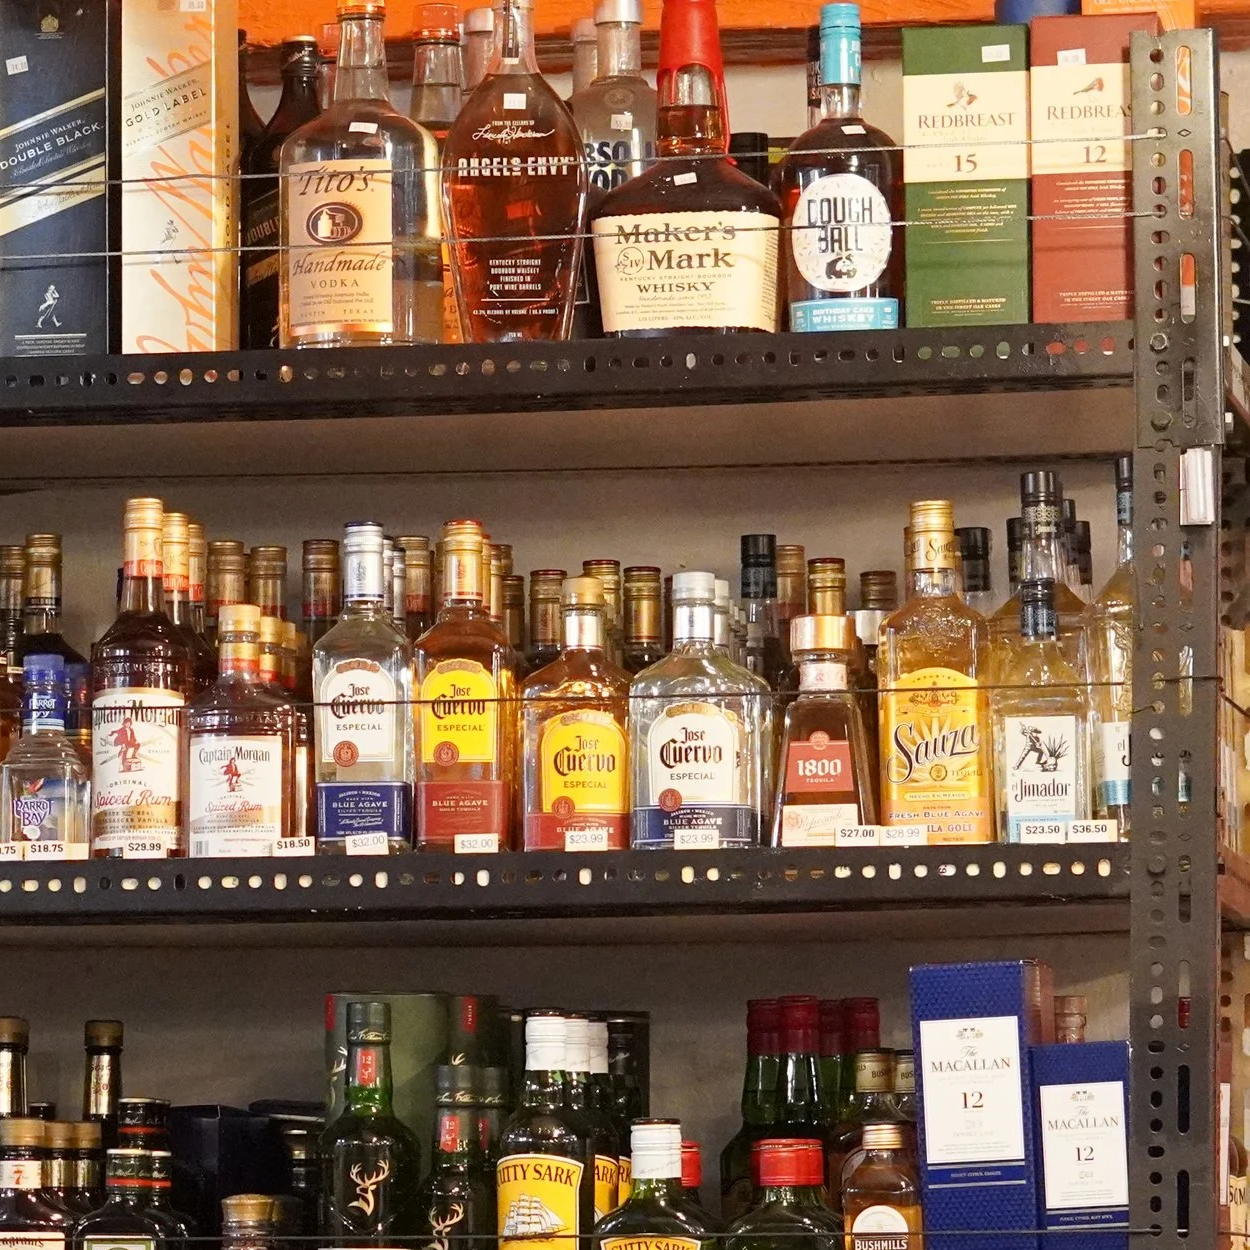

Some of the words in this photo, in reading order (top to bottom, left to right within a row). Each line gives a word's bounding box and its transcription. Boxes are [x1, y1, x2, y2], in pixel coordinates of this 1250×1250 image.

[918, 112, 1016, 129] REDBREAST
[1083, 145, 1108, 165] 12
[954, 154, 978, 174] 15
[299, 165, 375, 196] Tito's
[807, 196, 873, 226] DOUGH
[616, 221, 736, 245] Maker's
[292, 252, 386, 276] Handmade
[647, 249, 735, 271] Mark
[310, 279, 360, 289] VODKA
[637, 281, 715, 293] WHISKY
[348, 684, 370, 697] Jose
[450, 684, 471, 697] Jose
[437, 724, 484, 732] ESPECIAL
[680, 727, 706, 744] Jose
[575, 735, 599, 752] Jose
[553, 745, 616, 777] Cuervo
[659, 738, 722, 769] Cuervo
[887, 722, 980, 785] Sauza
[797, 759, 842, 776] 1800
[670, 772, 715, 781] ESPECIAL
[840, 829, 875, 838] $27.00
[885, 828, 920, 838] $28.99
[1025, 825, 1060, 835] $23.50
[1072, 824, 1107, 834] $36.50
[276, 839, 311, 849] $18.50
[460, 838, 493, 849] $32.00
[569, 833, 603, 844] $23.99
[30, 844, 64, 853] $18.75
[128, 842, 162, 852] $29.99
[930, 1057, 1009, 1073] MACALLAN
[959, 1090, 985, 1110] 12
[1074, 1146, 1095, 1162] 12
[534, 1165, 577, 1187] SARK
[855, 1239, 907, 1250] BUSHMILLS
